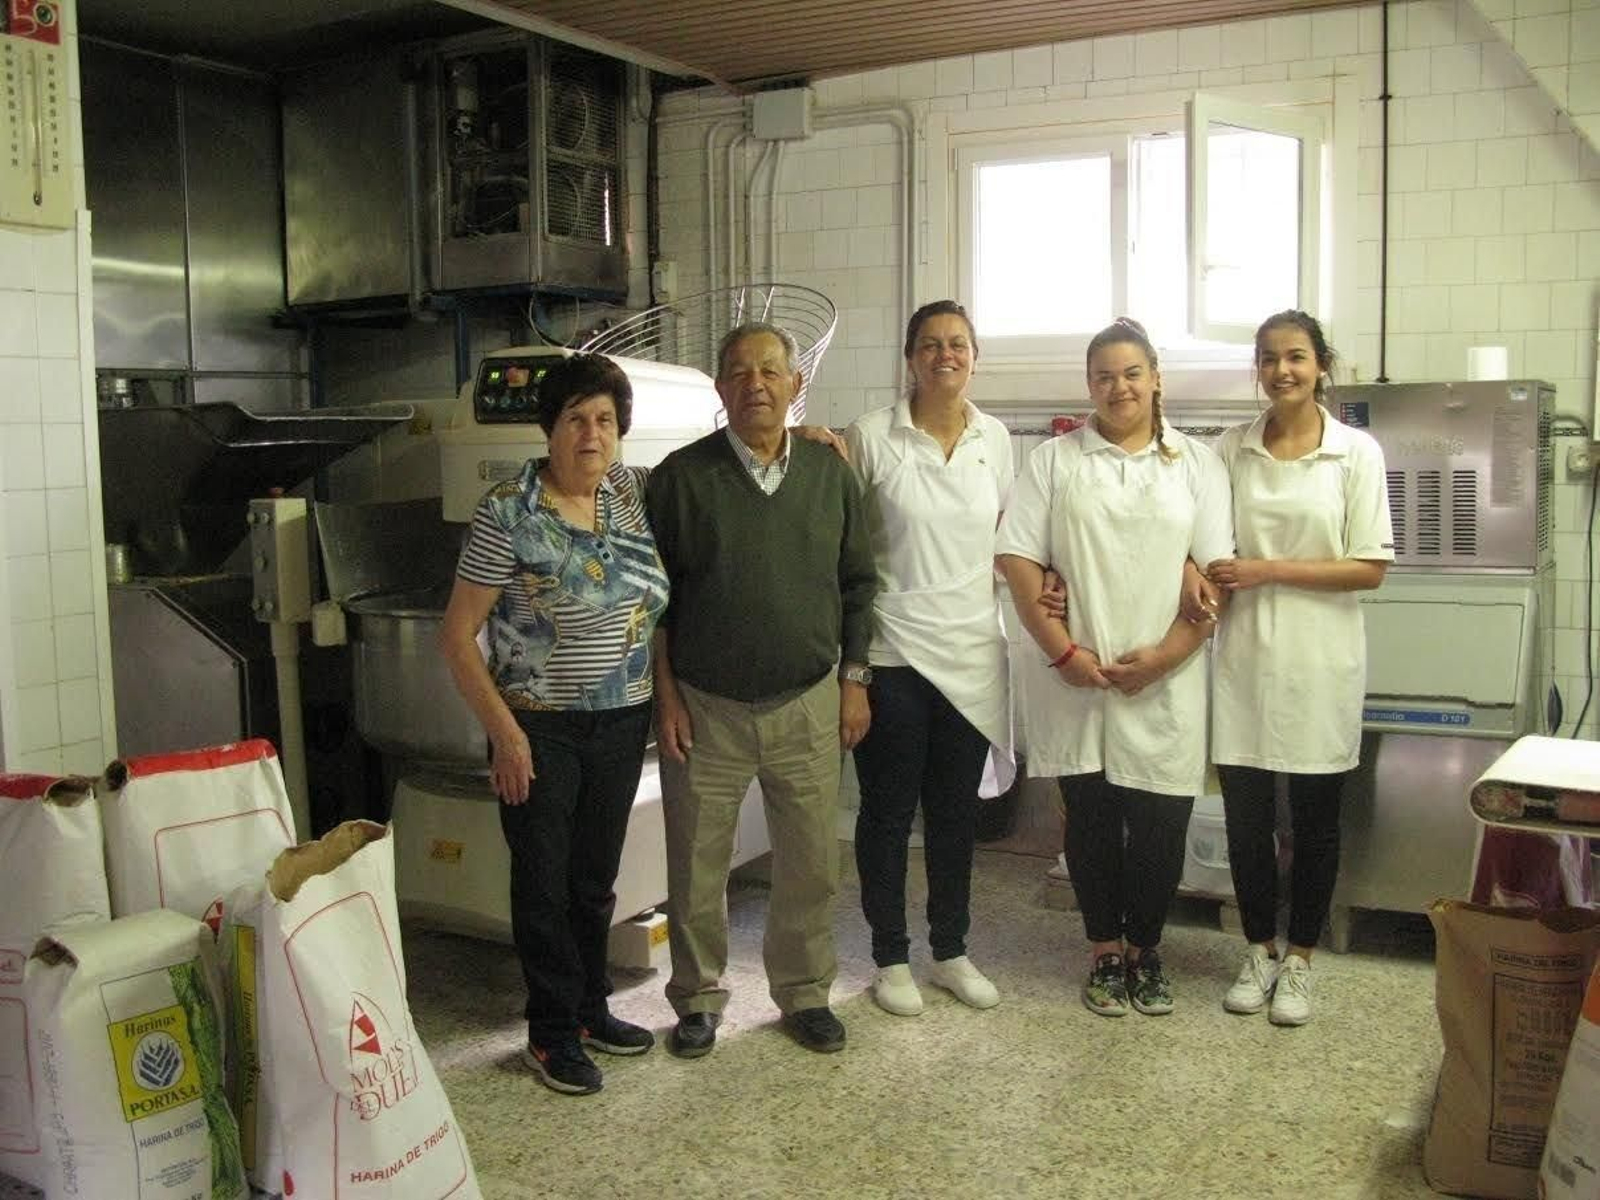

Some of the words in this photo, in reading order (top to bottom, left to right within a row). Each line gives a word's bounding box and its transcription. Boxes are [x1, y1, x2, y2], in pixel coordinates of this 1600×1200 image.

[125, 1016, 176, 1038] Harinas
[139, 1130, 172, 1149] HARINA
[350, 1158, 405, 1183] HARINA
[405, 1145, 422, 1164] DE
[423, 1119, 450, 1151] TRIGO
